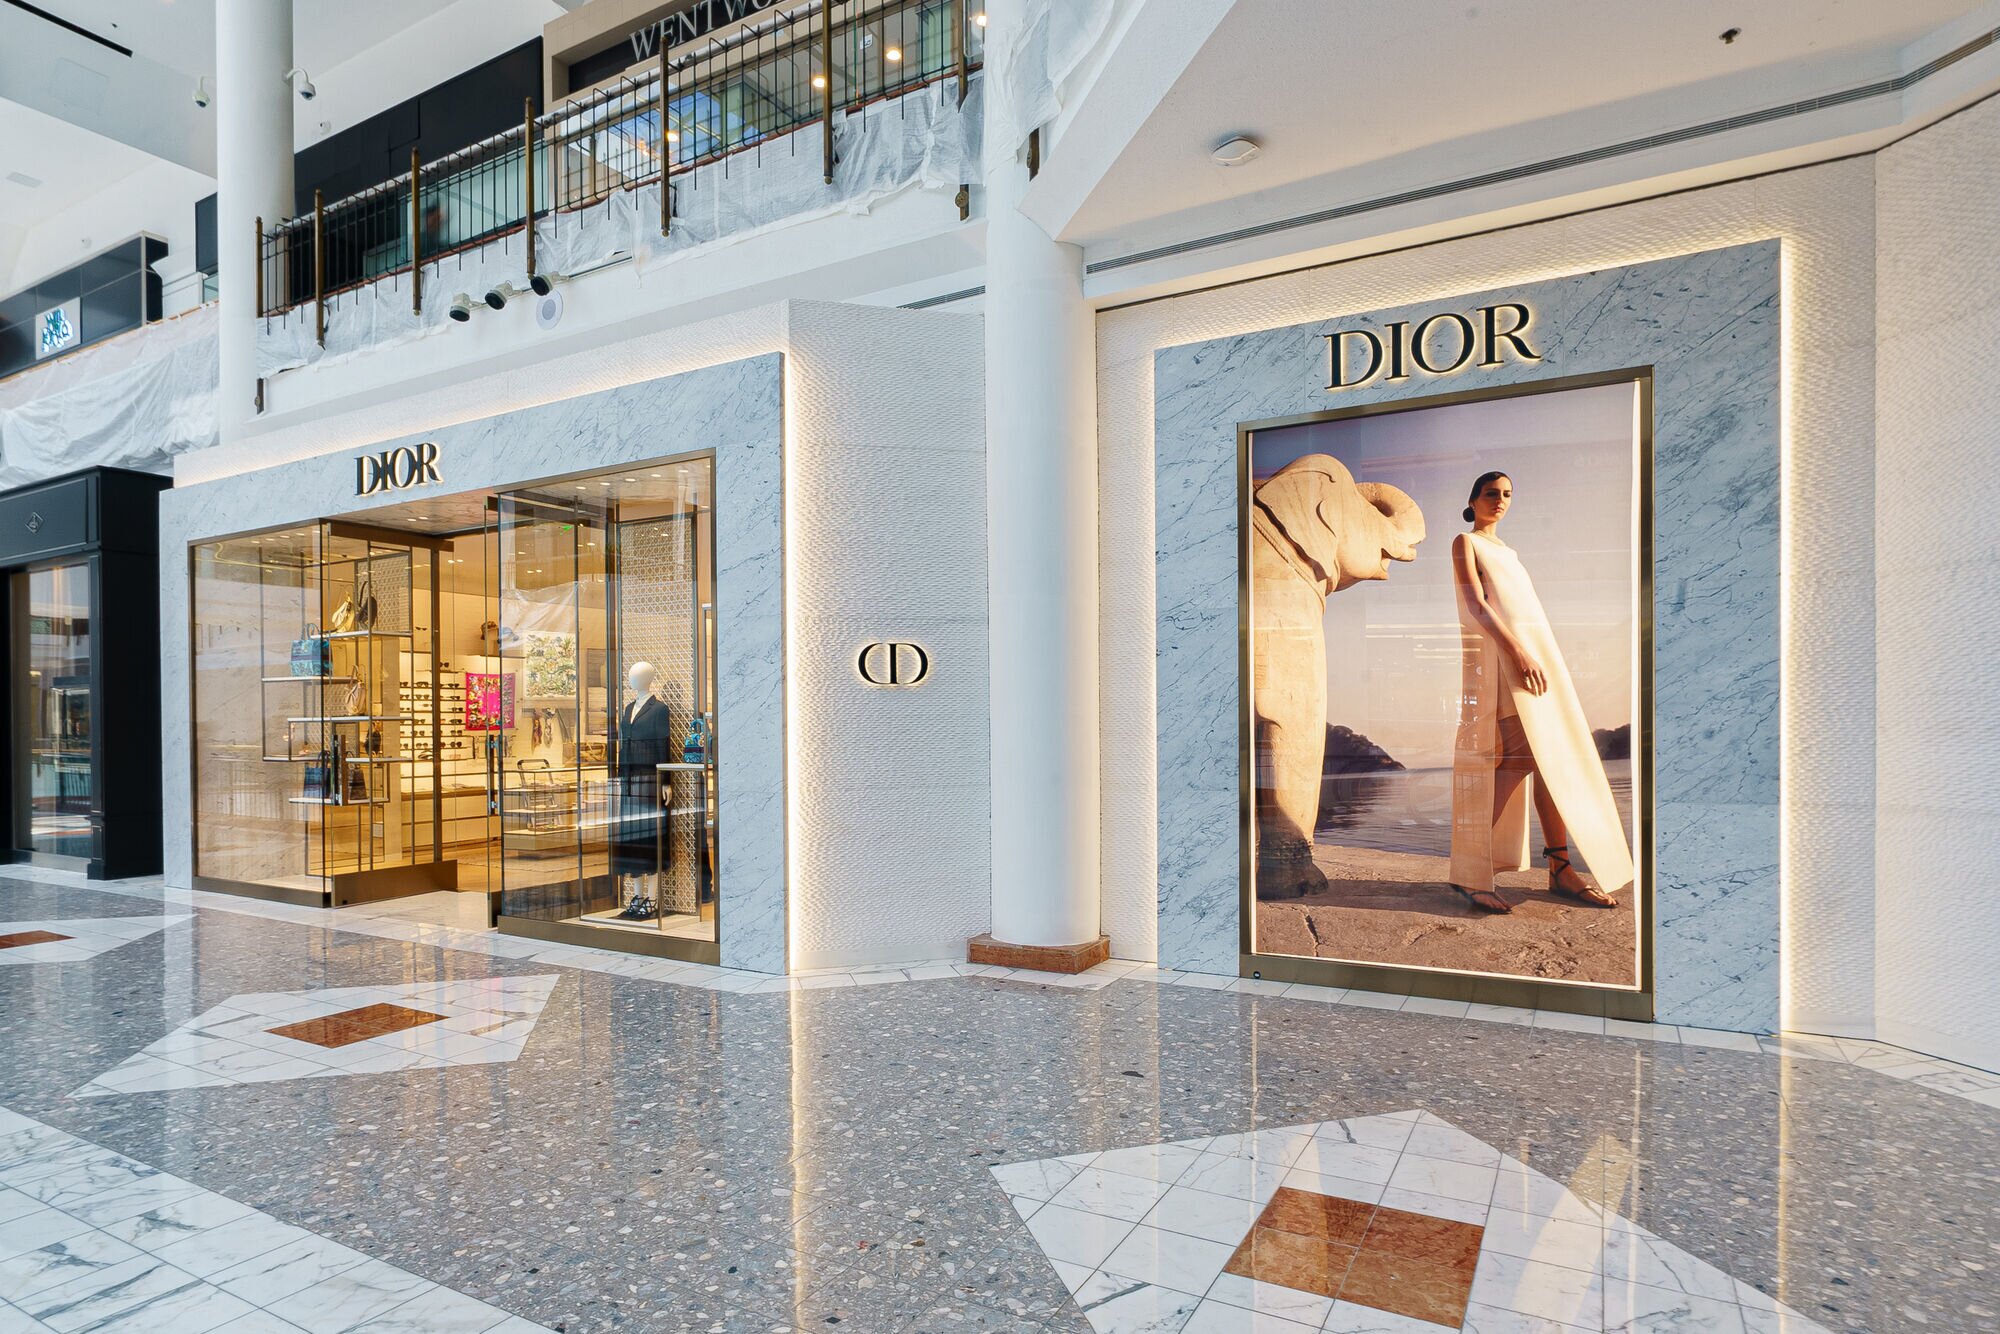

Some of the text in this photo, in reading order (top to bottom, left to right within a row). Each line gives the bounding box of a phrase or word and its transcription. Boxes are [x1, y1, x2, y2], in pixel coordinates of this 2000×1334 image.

[629, 0, 773, 62] WENTW
[1323, 303, 1542, 390] DIOR
[353, 442, 442, 496] DIOR
[858, 642, 929, 685] CD
